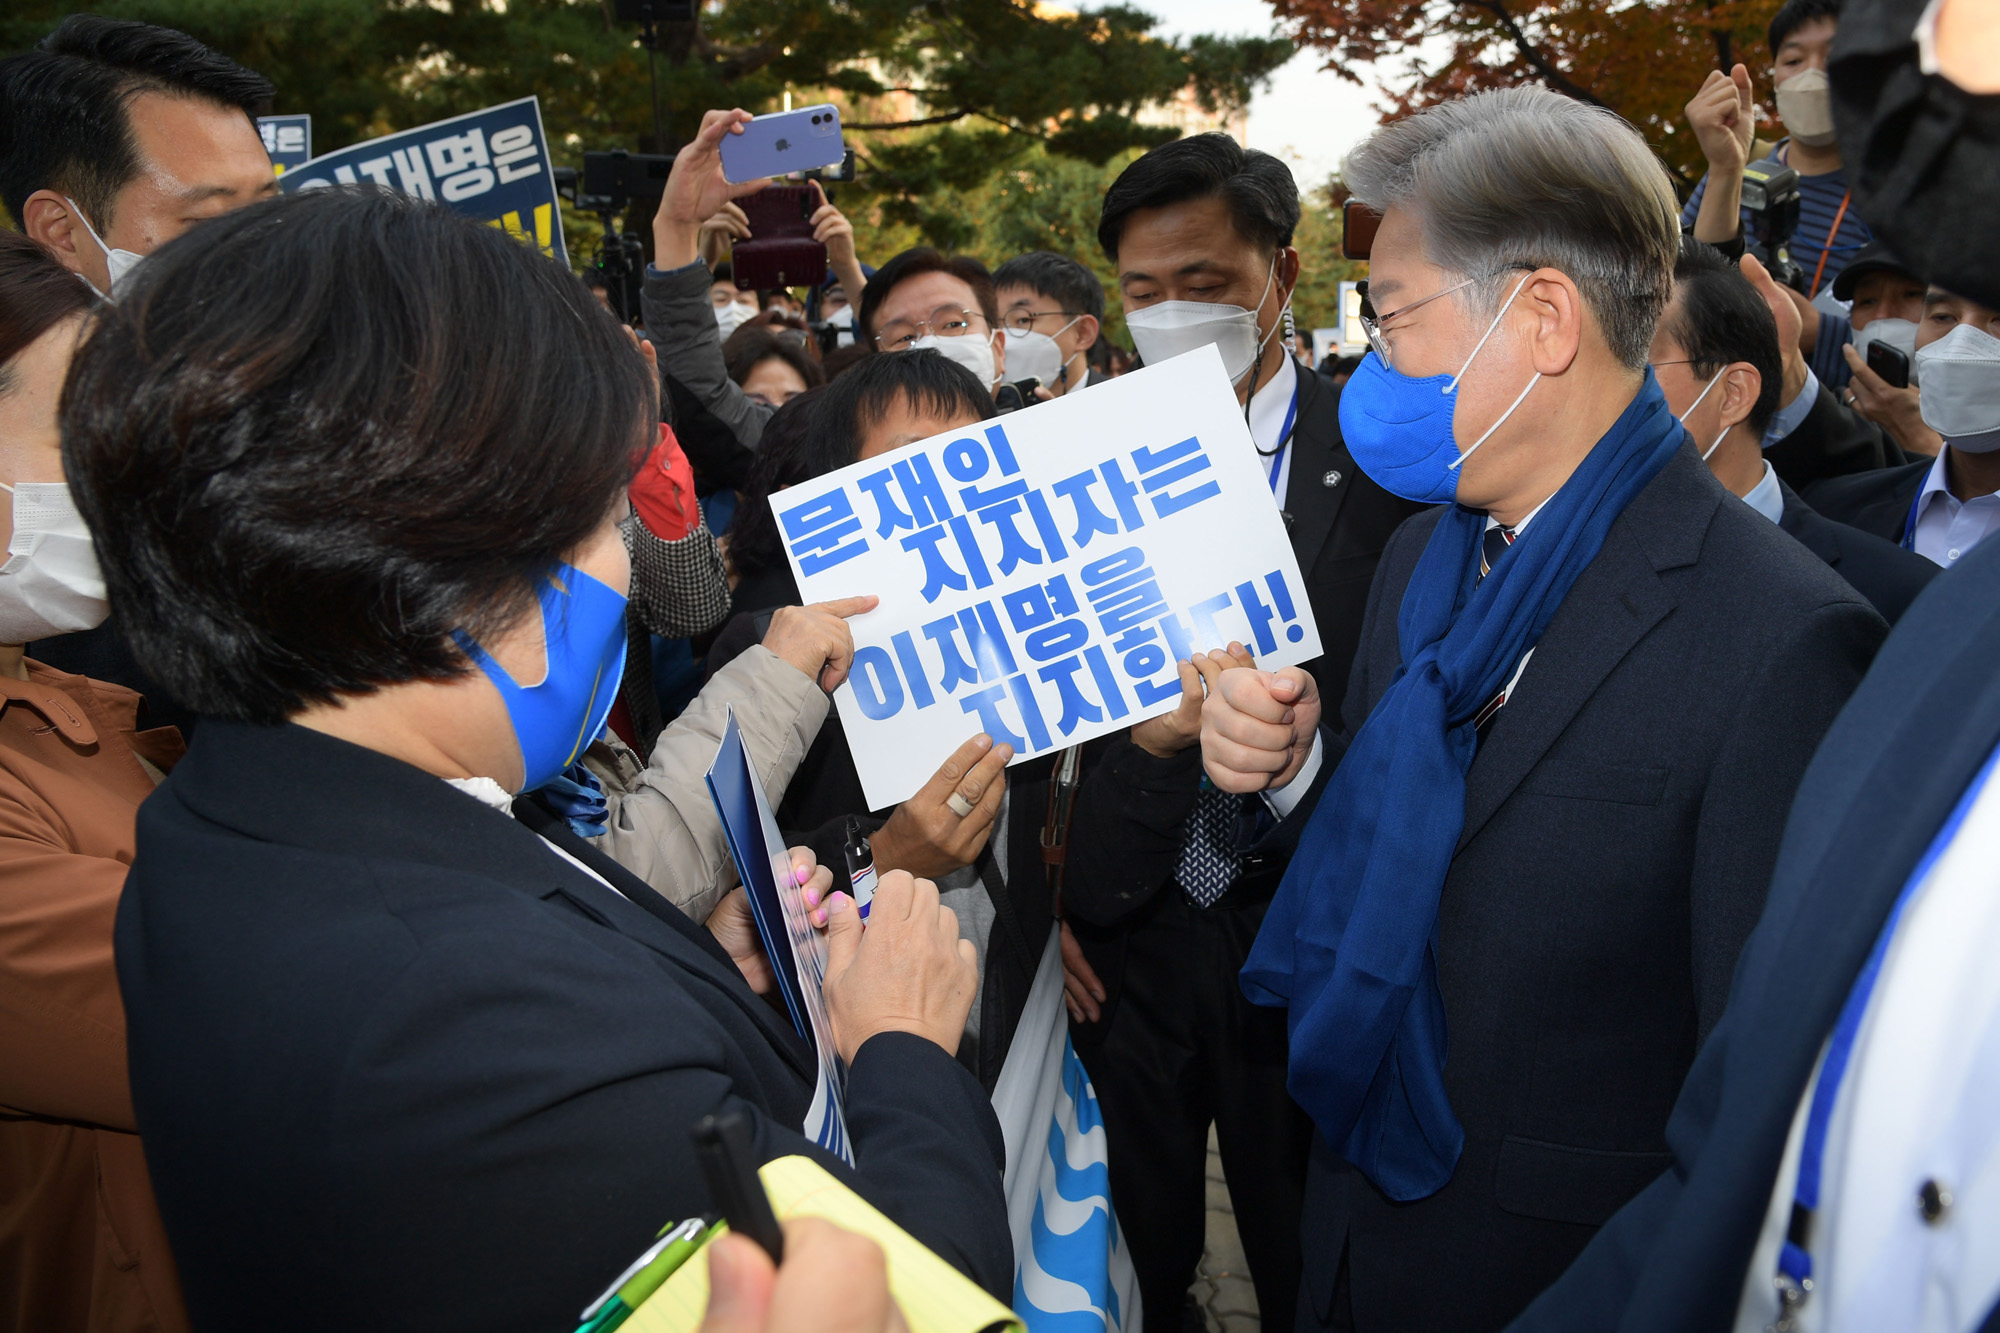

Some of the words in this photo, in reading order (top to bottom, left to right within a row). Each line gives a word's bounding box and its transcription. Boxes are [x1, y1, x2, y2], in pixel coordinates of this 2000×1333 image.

[779, 424, 1029, 577] 문재인
[900, 436, 1221, 604] 지지자는
[848, 546, 1170, 721] 이재명을
[958, 569, 1304, 755] 지지한다!
